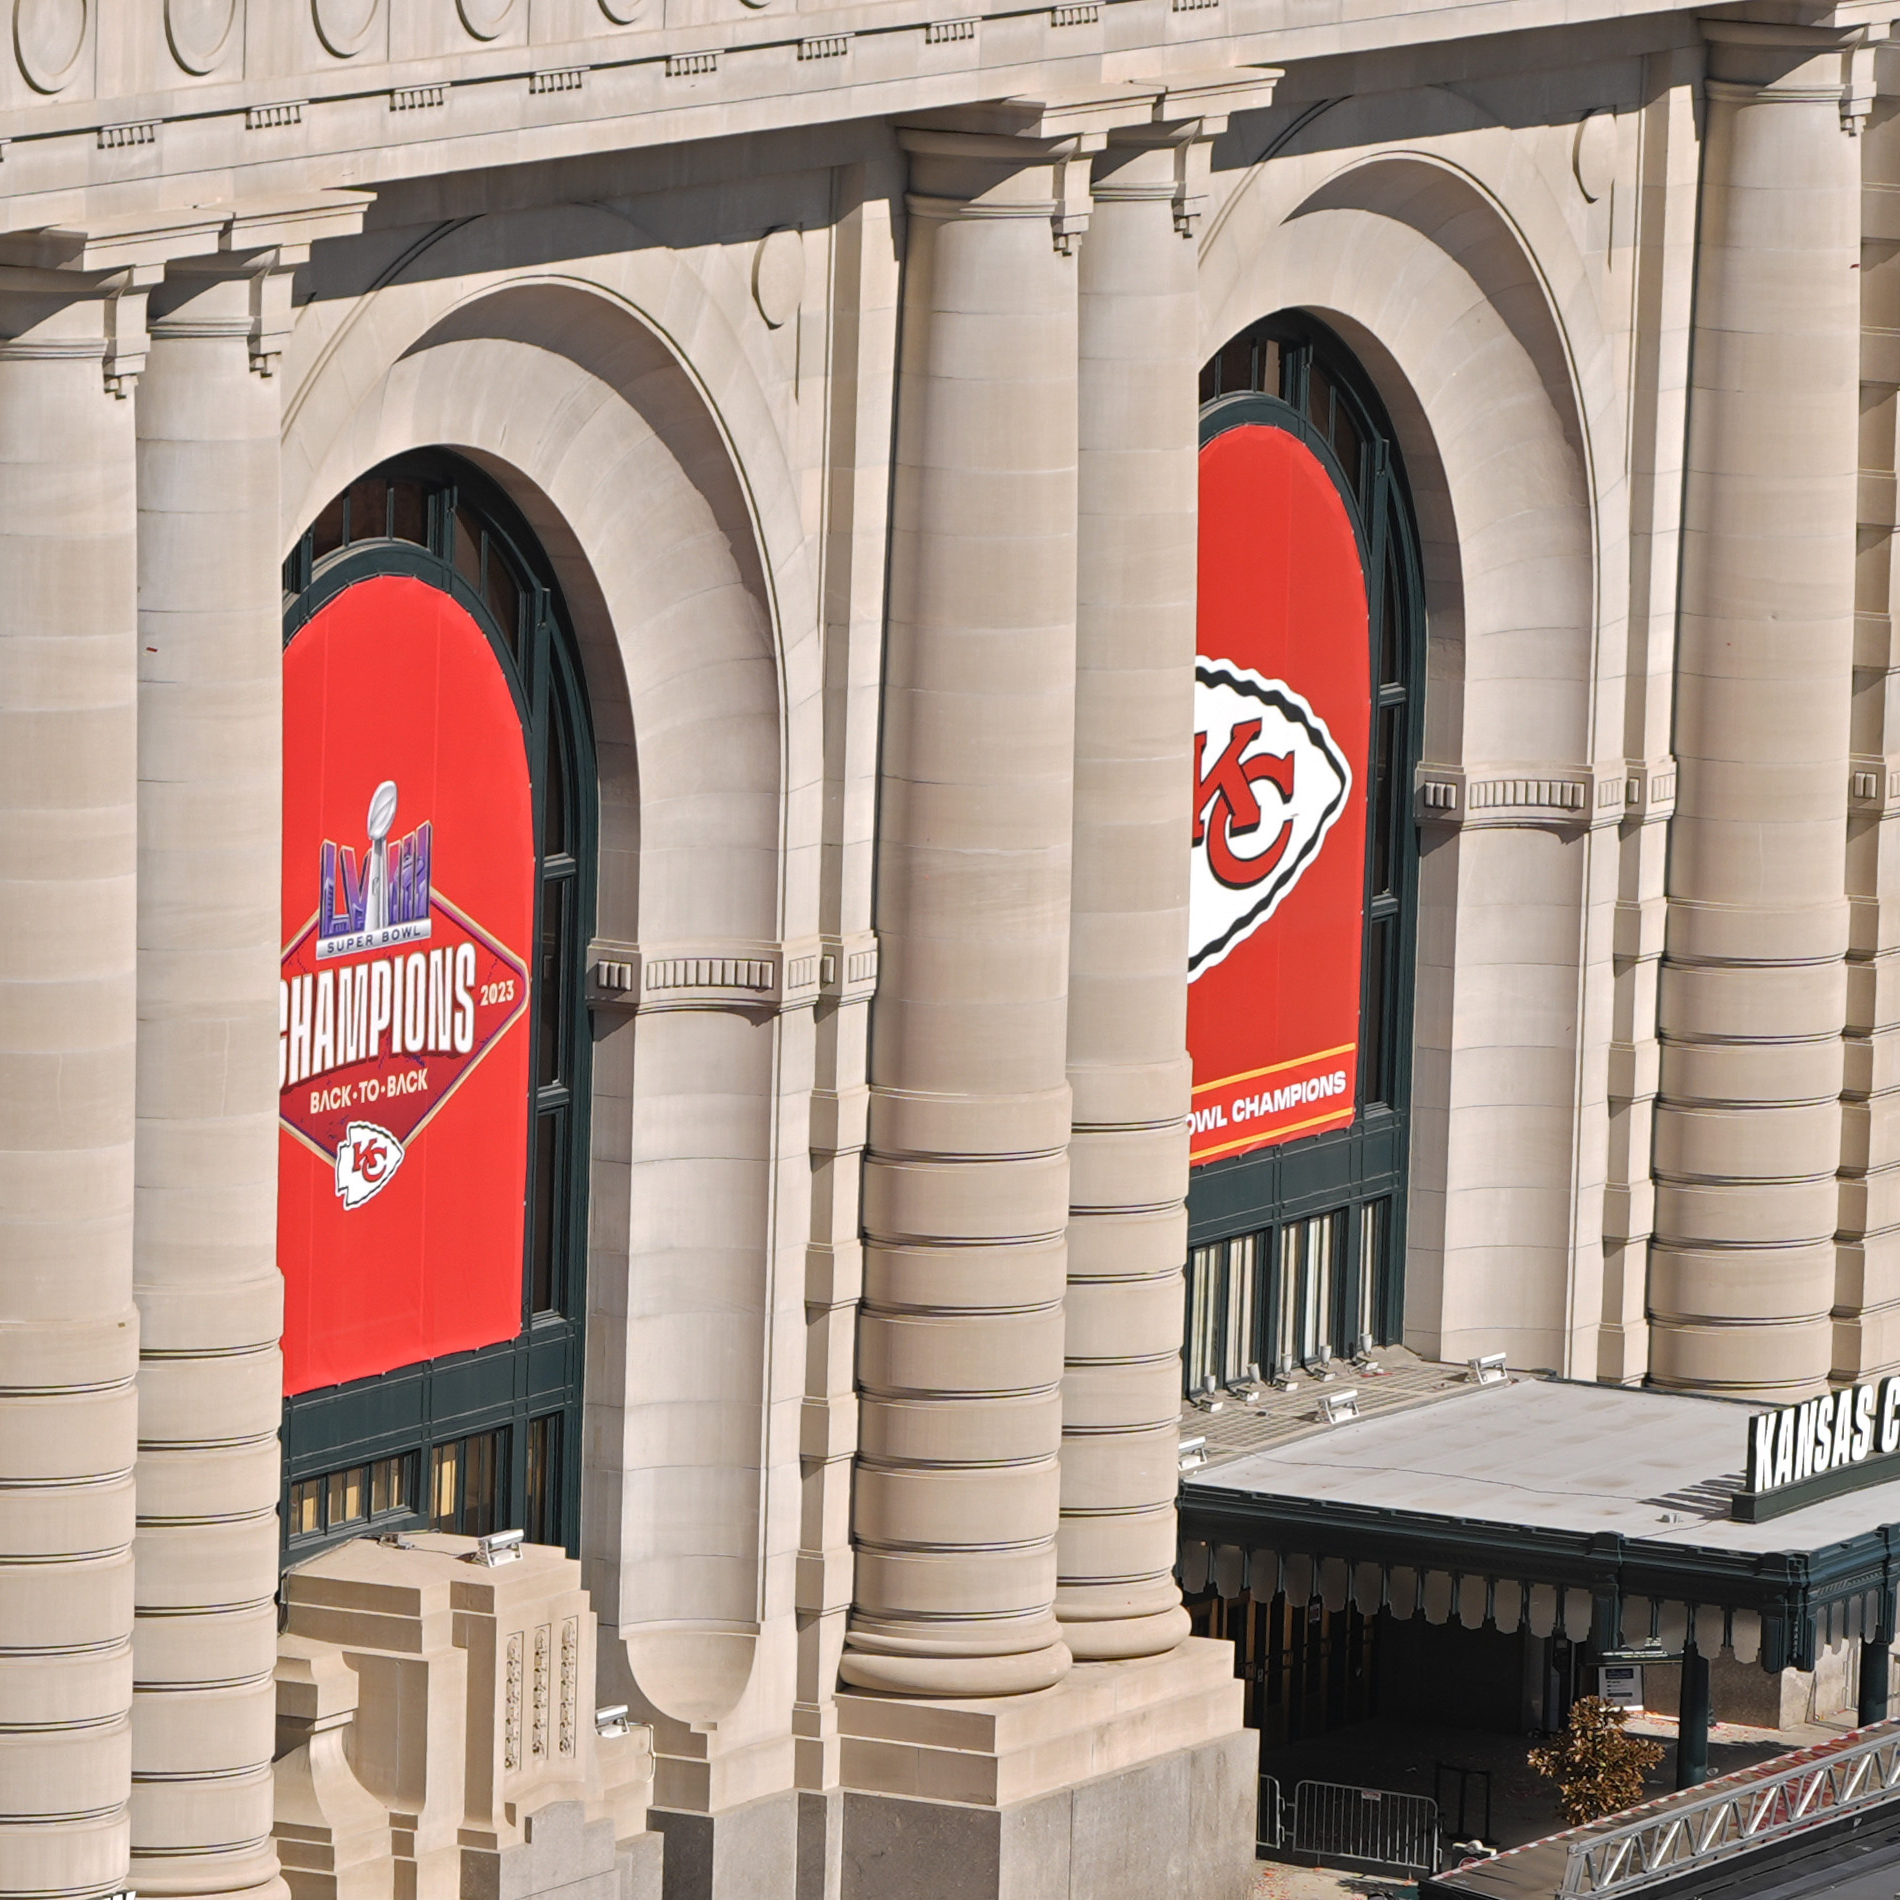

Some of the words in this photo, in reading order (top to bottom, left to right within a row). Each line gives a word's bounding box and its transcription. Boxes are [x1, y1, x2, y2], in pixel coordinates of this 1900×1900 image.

[326, 933, 374, 955] SUPER
[381, 926, 422, 943] BOWL
[480, 979, 516, 1007] 2023
[1231, 1070, 1347, 1123] CHAMPIONS
[1751, 1383, 1874, 1494] KANSAS
